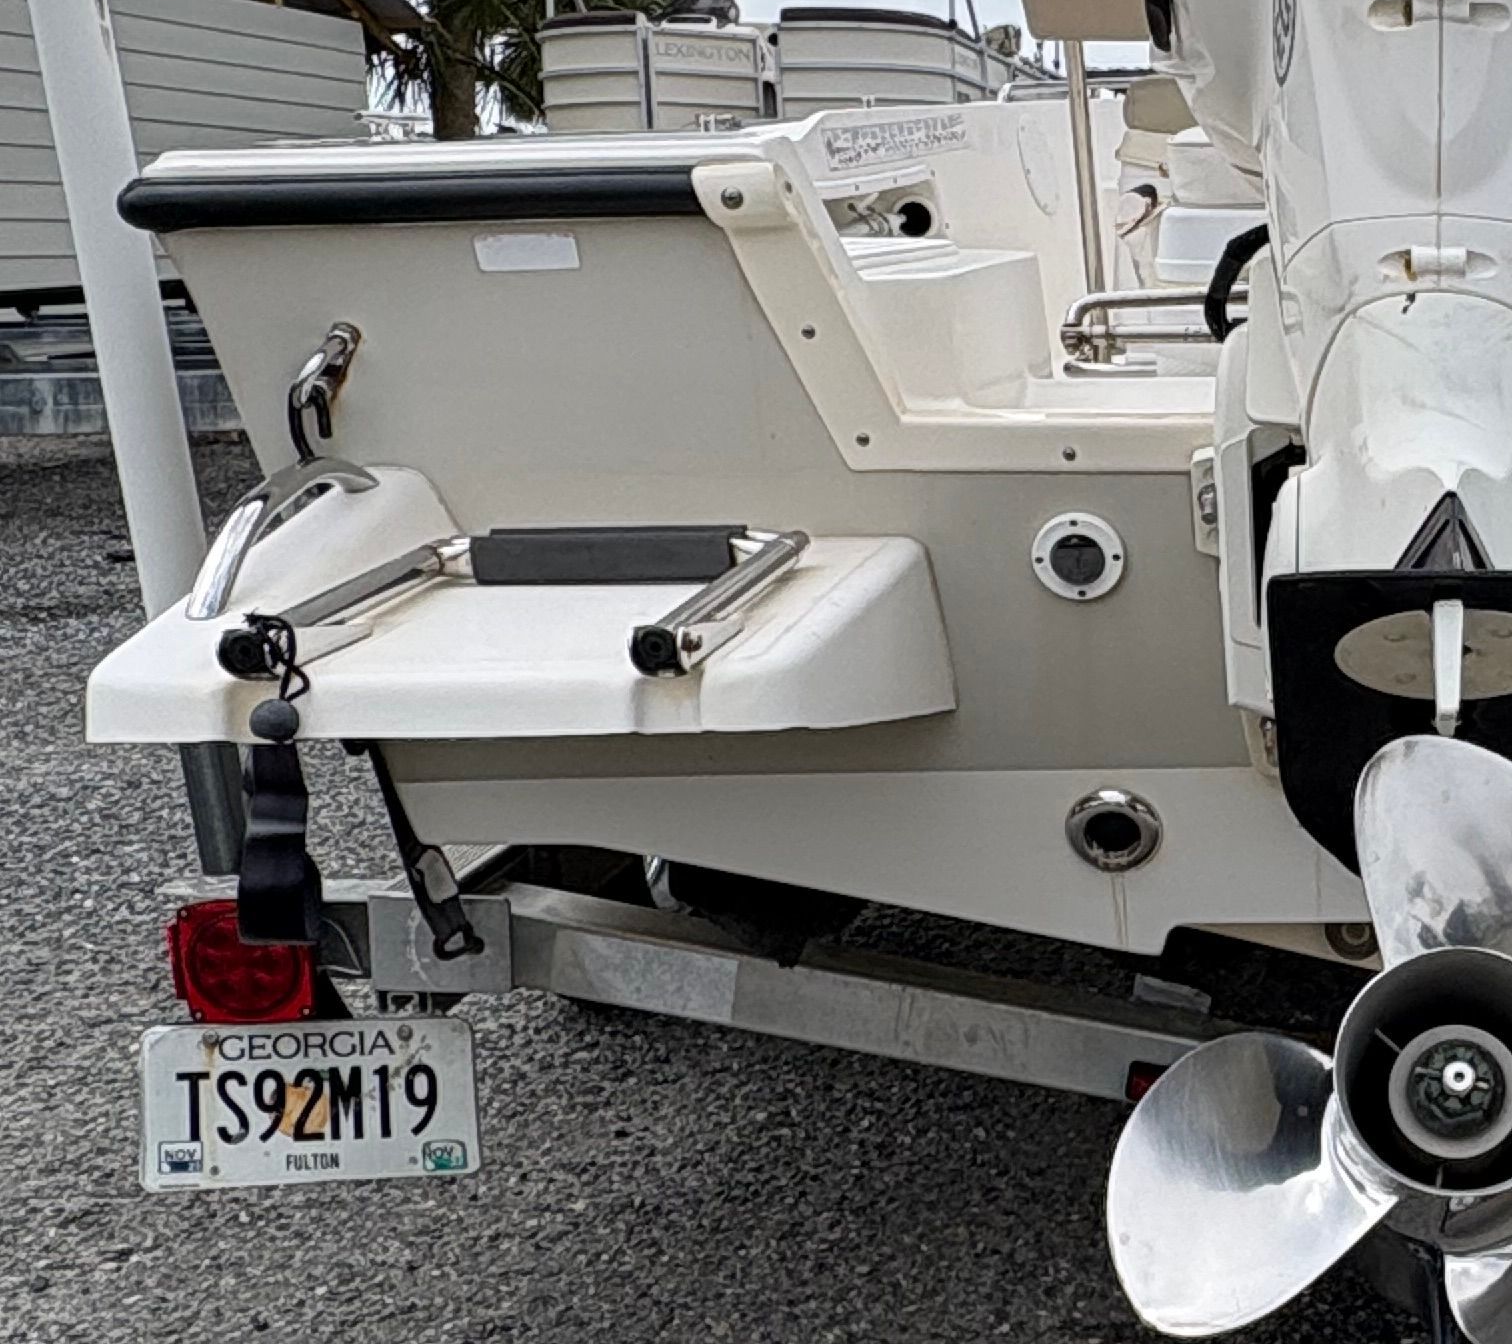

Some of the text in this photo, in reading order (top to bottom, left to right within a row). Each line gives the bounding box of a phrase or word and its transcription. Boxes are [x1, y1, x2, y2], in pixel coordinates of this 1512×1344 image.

[218, 1030, 396, 1062] GEORGIA
[175, 1064, 438, 1145] TS92M19
[285, 1152, 341, 1172] FULTON
